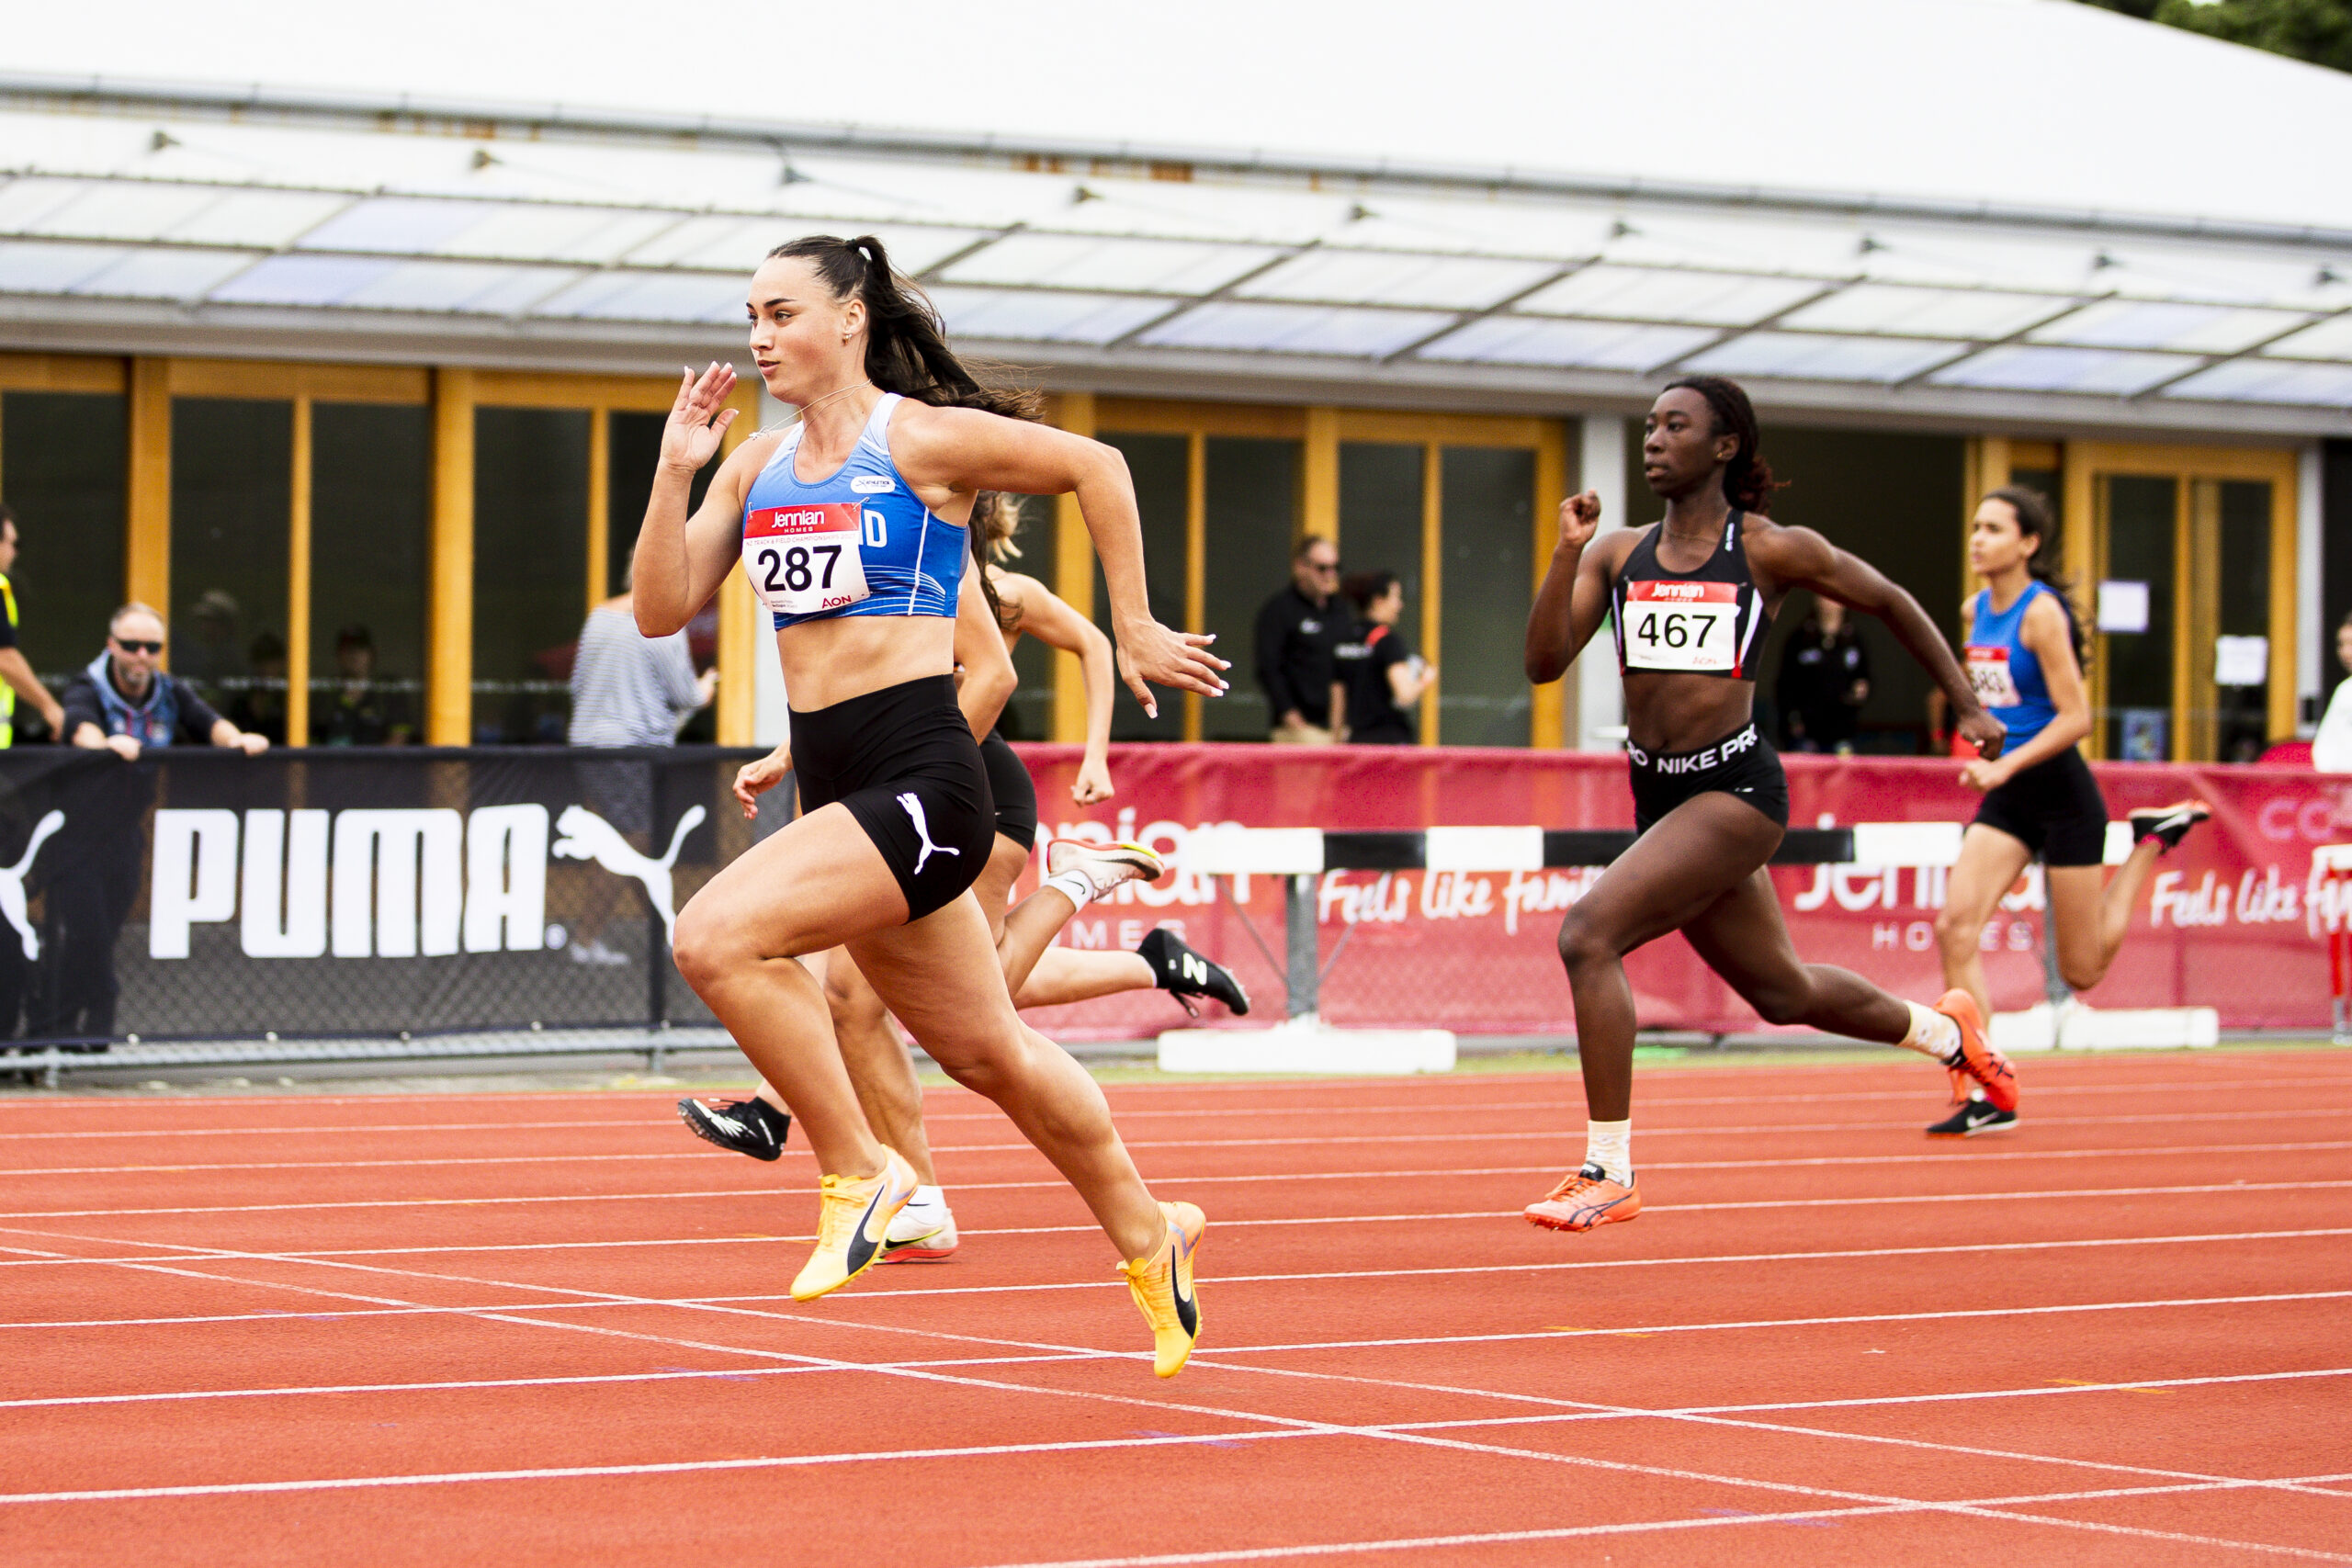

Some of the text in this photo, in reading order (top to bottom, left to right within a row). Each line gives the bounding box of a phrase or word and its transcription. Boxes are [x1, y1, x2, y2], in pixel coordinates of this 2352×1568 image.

[771, 509, 825, 529] Jennian
[860, 509, 888, 548] D
[757, 545, 842, 592] 287
[821, 595, 852, 609] AON
[1638, 613, 1717, 648] 467
[1657, 749, 1718, 774] NIKE
[149, 803, 549, 959] PUMA
[2150, 868, 2233, 929] Feels
[1871, 920, 2035, 952] HOES
